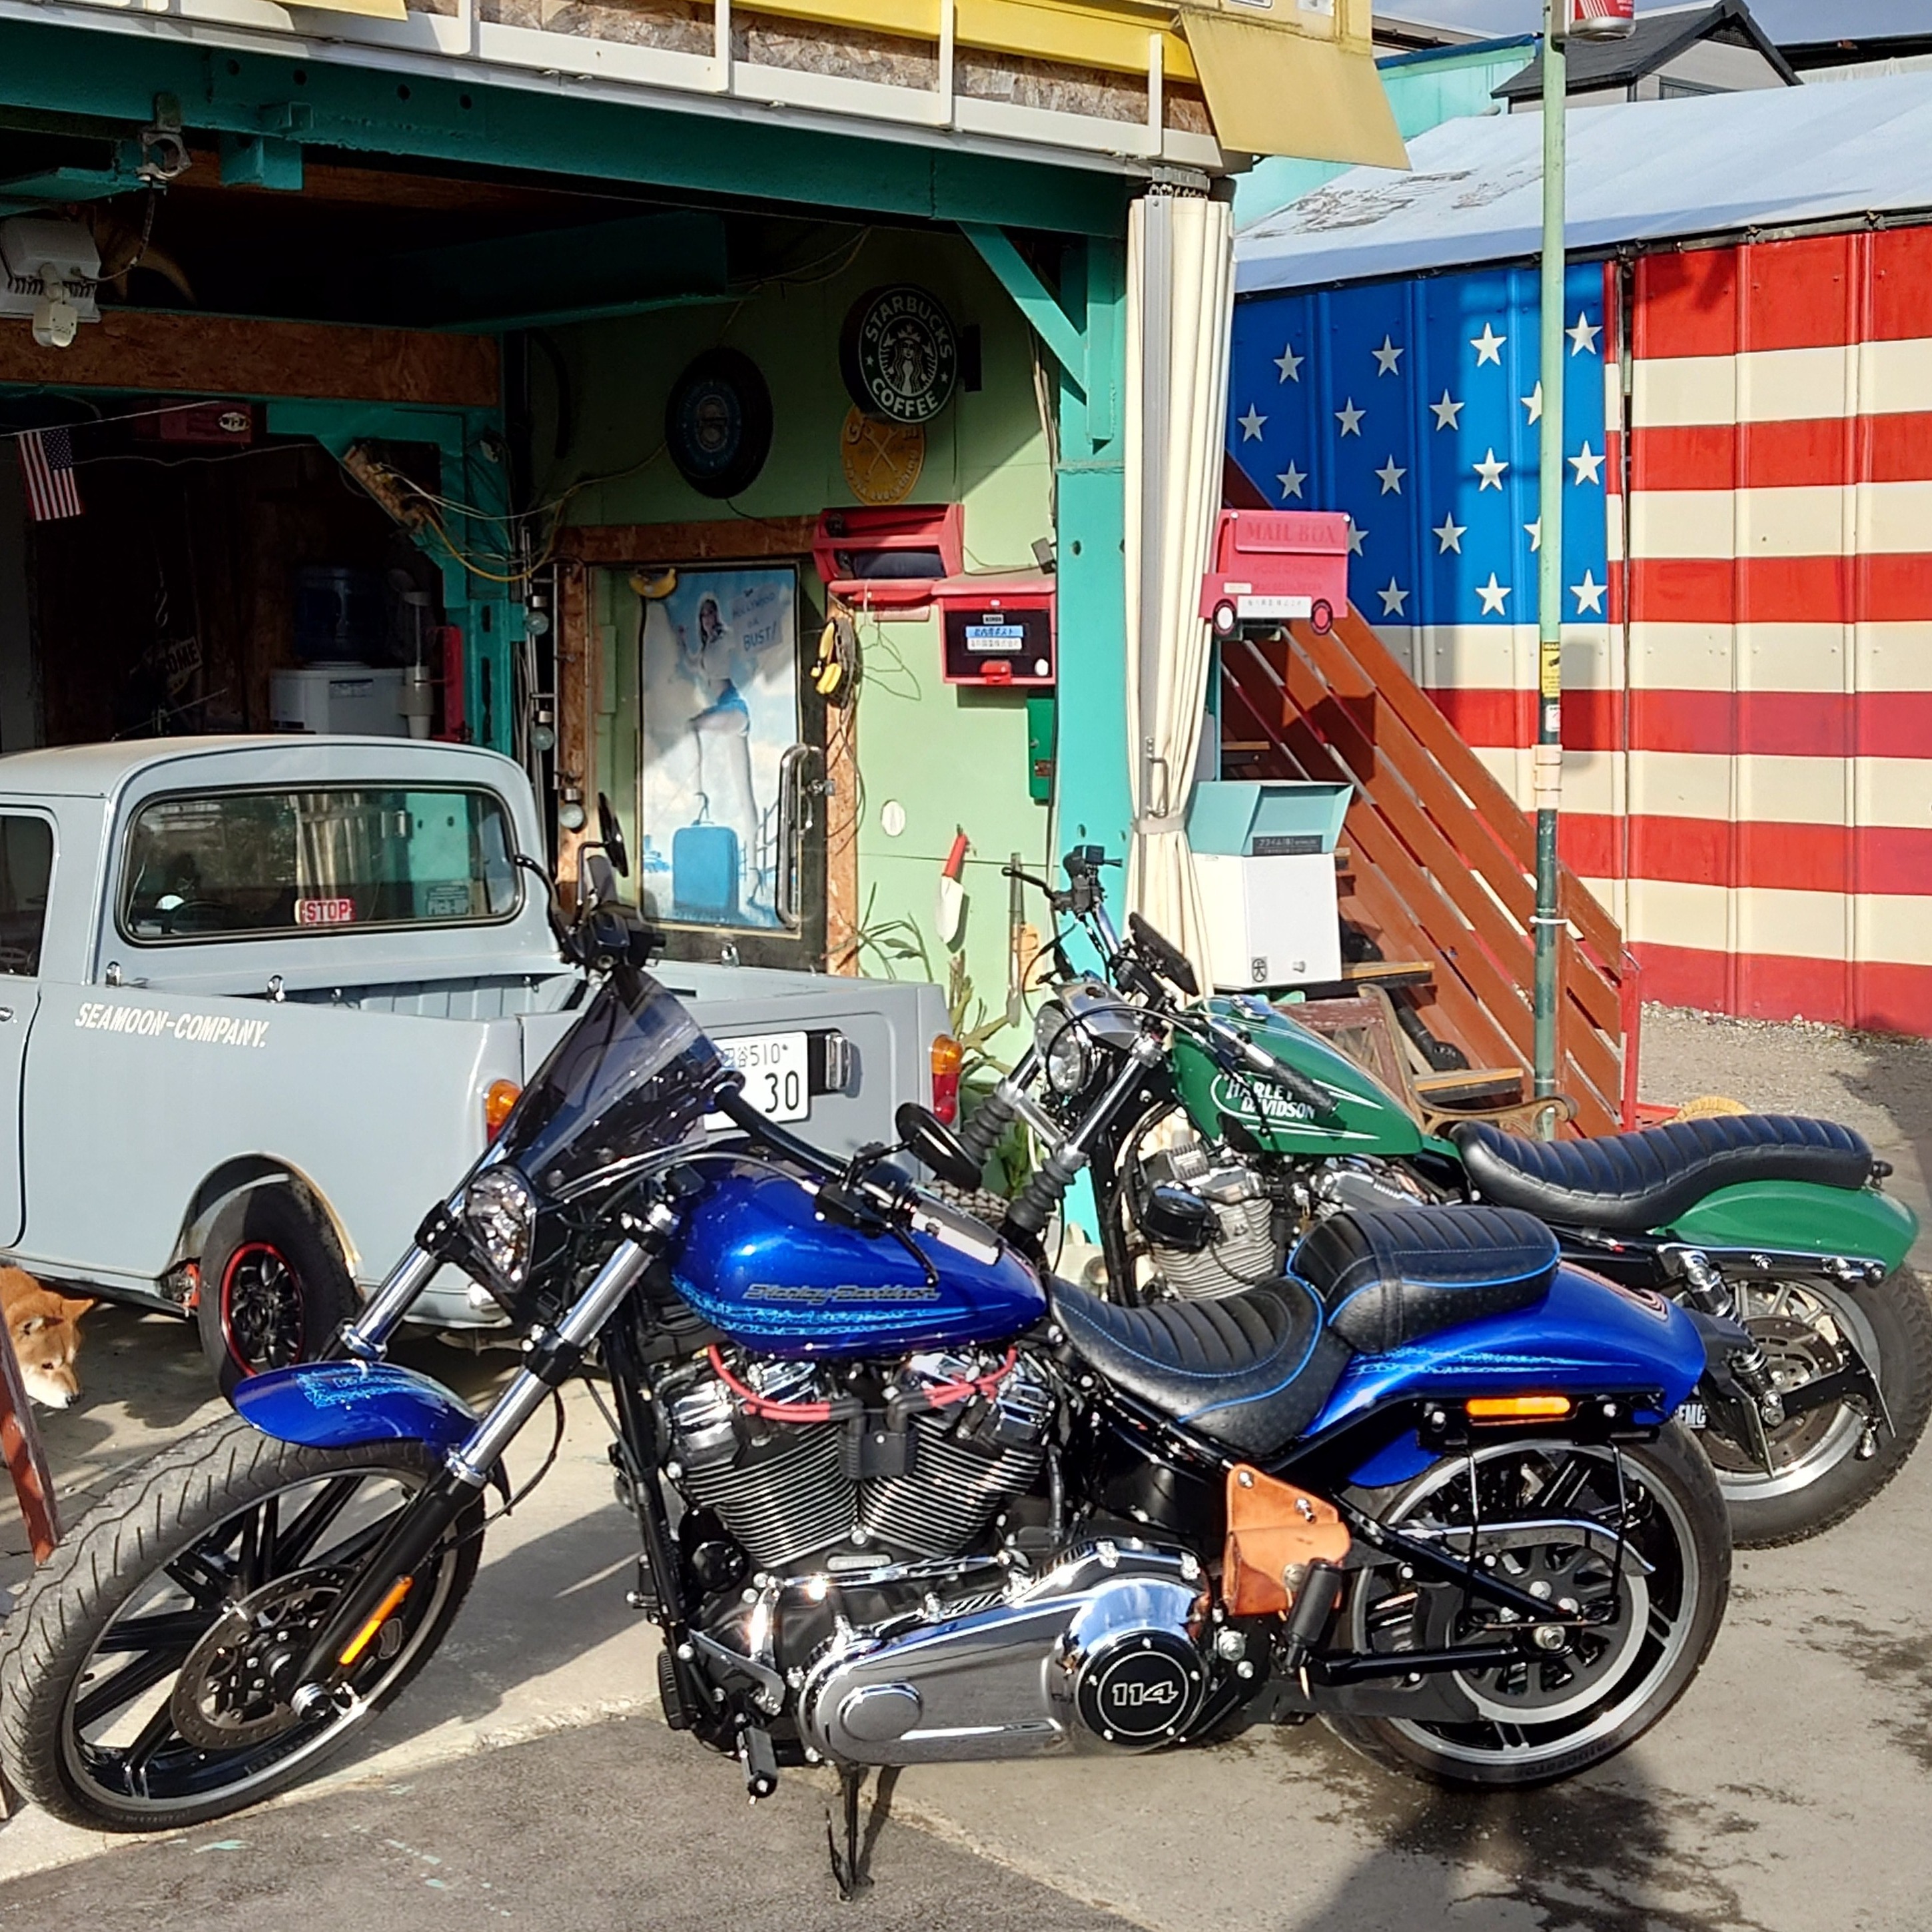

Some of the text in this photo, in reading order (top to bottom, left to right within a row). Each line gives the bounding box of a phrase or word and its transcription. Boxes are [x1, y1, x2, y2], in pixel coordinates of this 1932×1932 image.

[866, 295, 953, 358] STARBUCKS
[871, 378, 938, 417] COFFEE
[1246, 522, 1338, 544] MAIL BOX
[743, 620, 777, 652] BUST!
[306, 901, 349, 921] STOP
[74, 1003, 270, 1048] SEAMOON-COMPANY.
[764, 1070, 799, 1113] 30
[1112, 1680, 1179, 1706] 114
